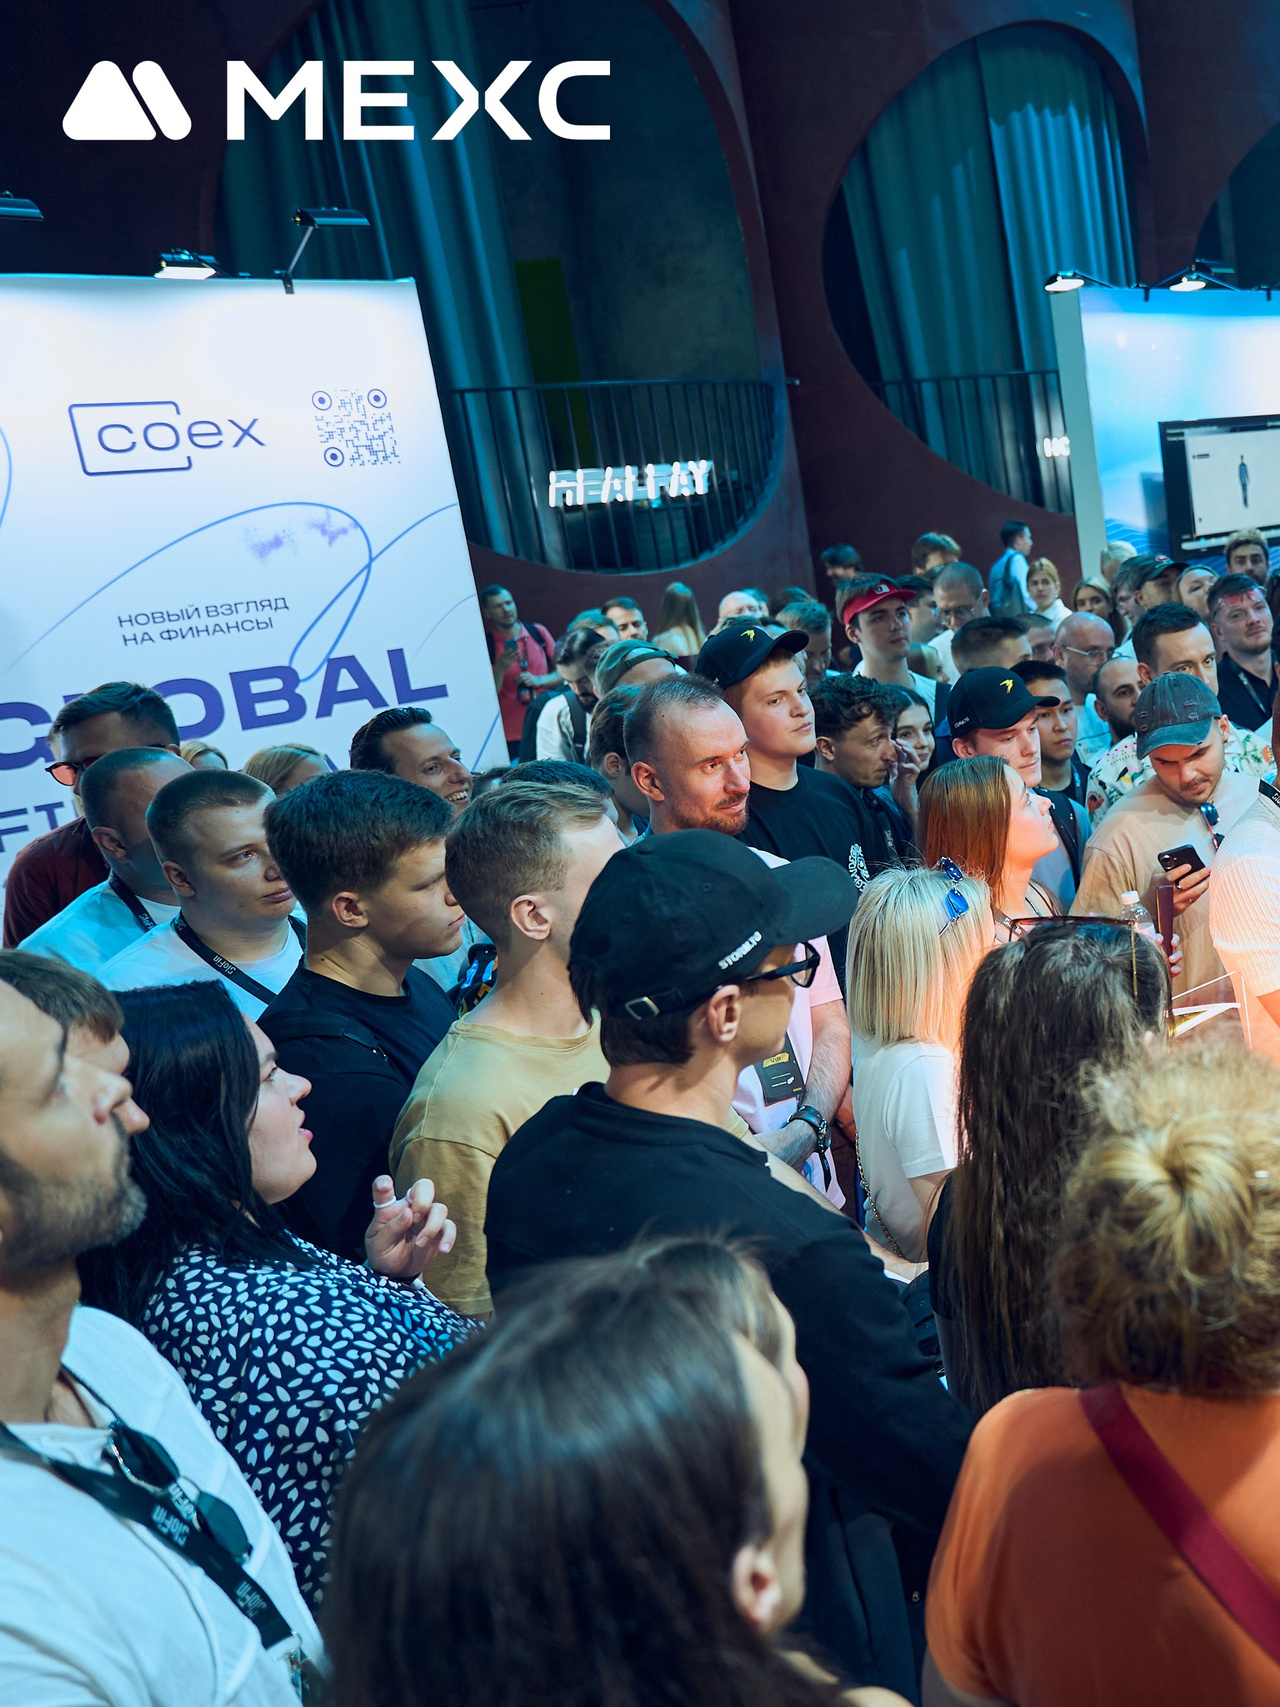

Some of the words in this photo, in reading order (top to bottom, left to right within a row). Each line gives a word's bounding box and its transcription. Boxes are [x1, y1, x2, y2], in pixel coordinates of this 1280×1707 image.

[97, 418, 266, 453] coex
[118, 604, 201, 629] НОВЫЙ
[205, 597, 289, 618] ВЗГЛЯД
[122, 631, 155, 647] НА
[159, 617, 274, 643] ФИНАНСЫ
[0, 648, 448, 770] GOBAL
